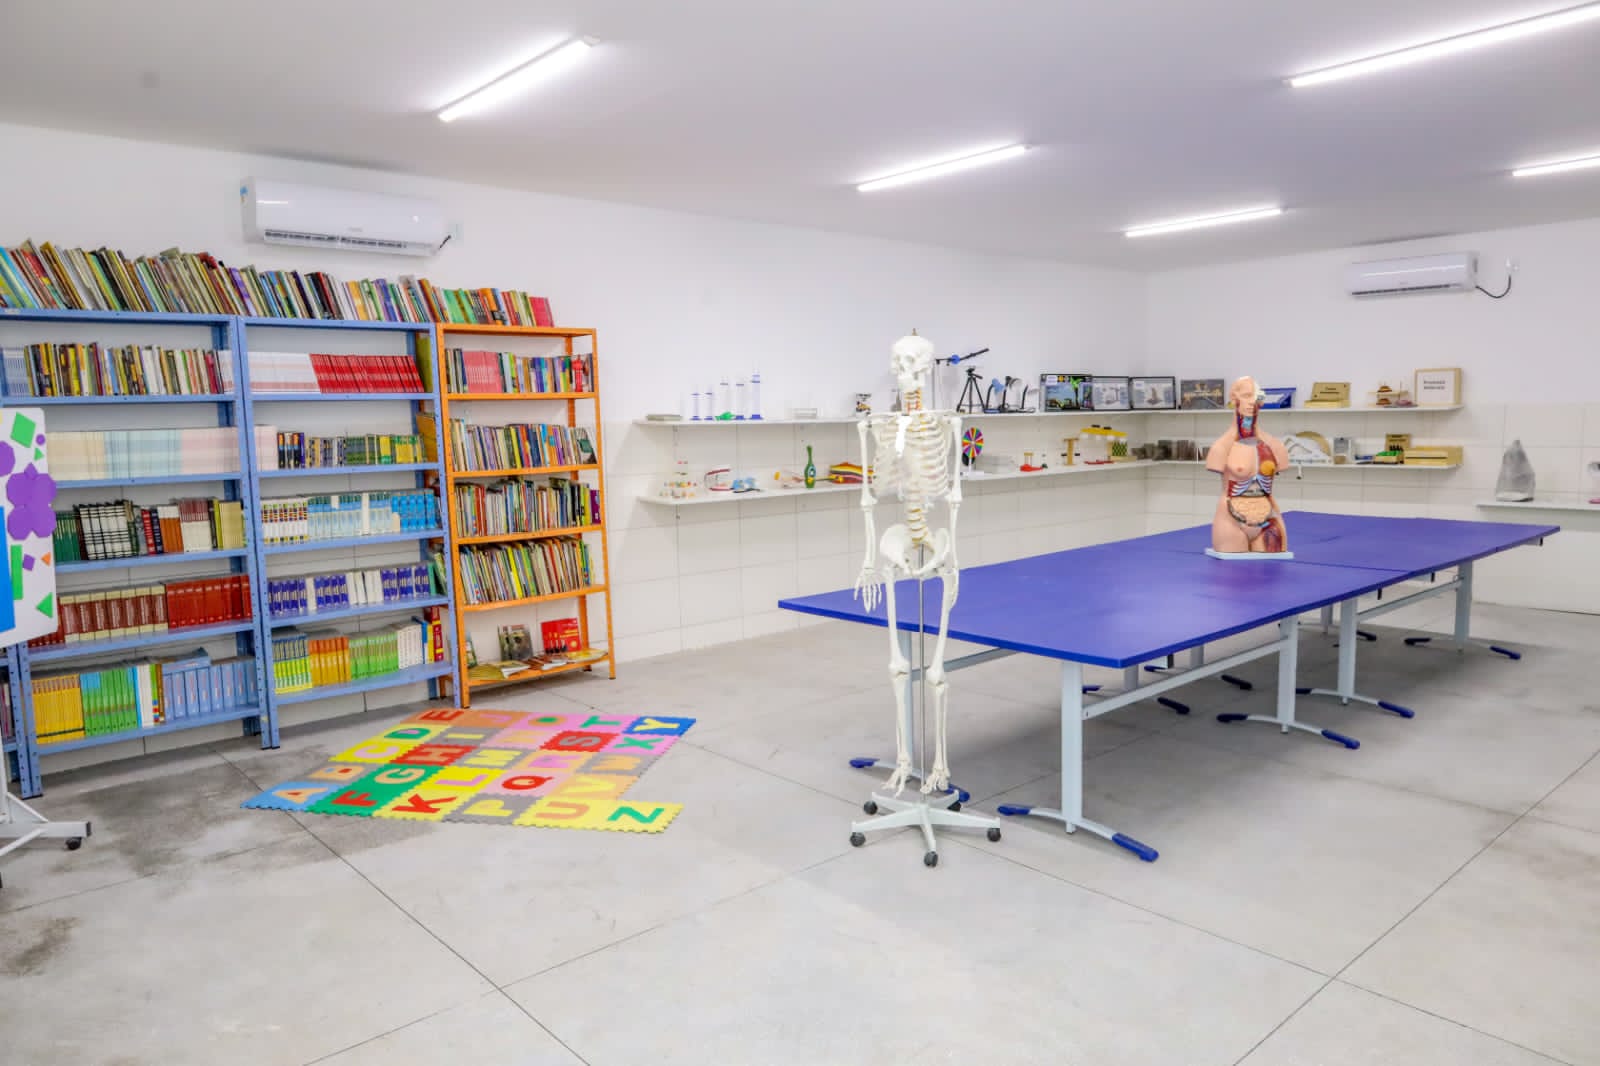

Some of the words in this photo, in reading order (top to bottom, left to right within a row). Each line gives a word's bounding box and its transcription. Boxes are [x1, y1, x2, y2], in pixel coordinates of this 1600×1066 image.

[580, 715, 622, 728] T
[633, 718, 680, 731] Y
[559, 736, 602, 747] S
[613, 737, 664, 750] X
[272, 787, 329, 804] A
[307, 765, 365, 780] B
[363, 744, 401, 760] C
[384, 728, 431, 739] D
[418, 710, 465, 721] E
[331, 790, 377, 807] F
[374, 768, 426, 784] G
[406, 747, 460, 762] H
[501, 775, 554, 790] Q
[561, 776, 617, 793] V
[391, 793, 459, 813] K
[434, 774, 489, 787] L
[462, 800, 514, 817] P
[535, 801, 590, 820] U
[607, 806, 666, 824] Z
